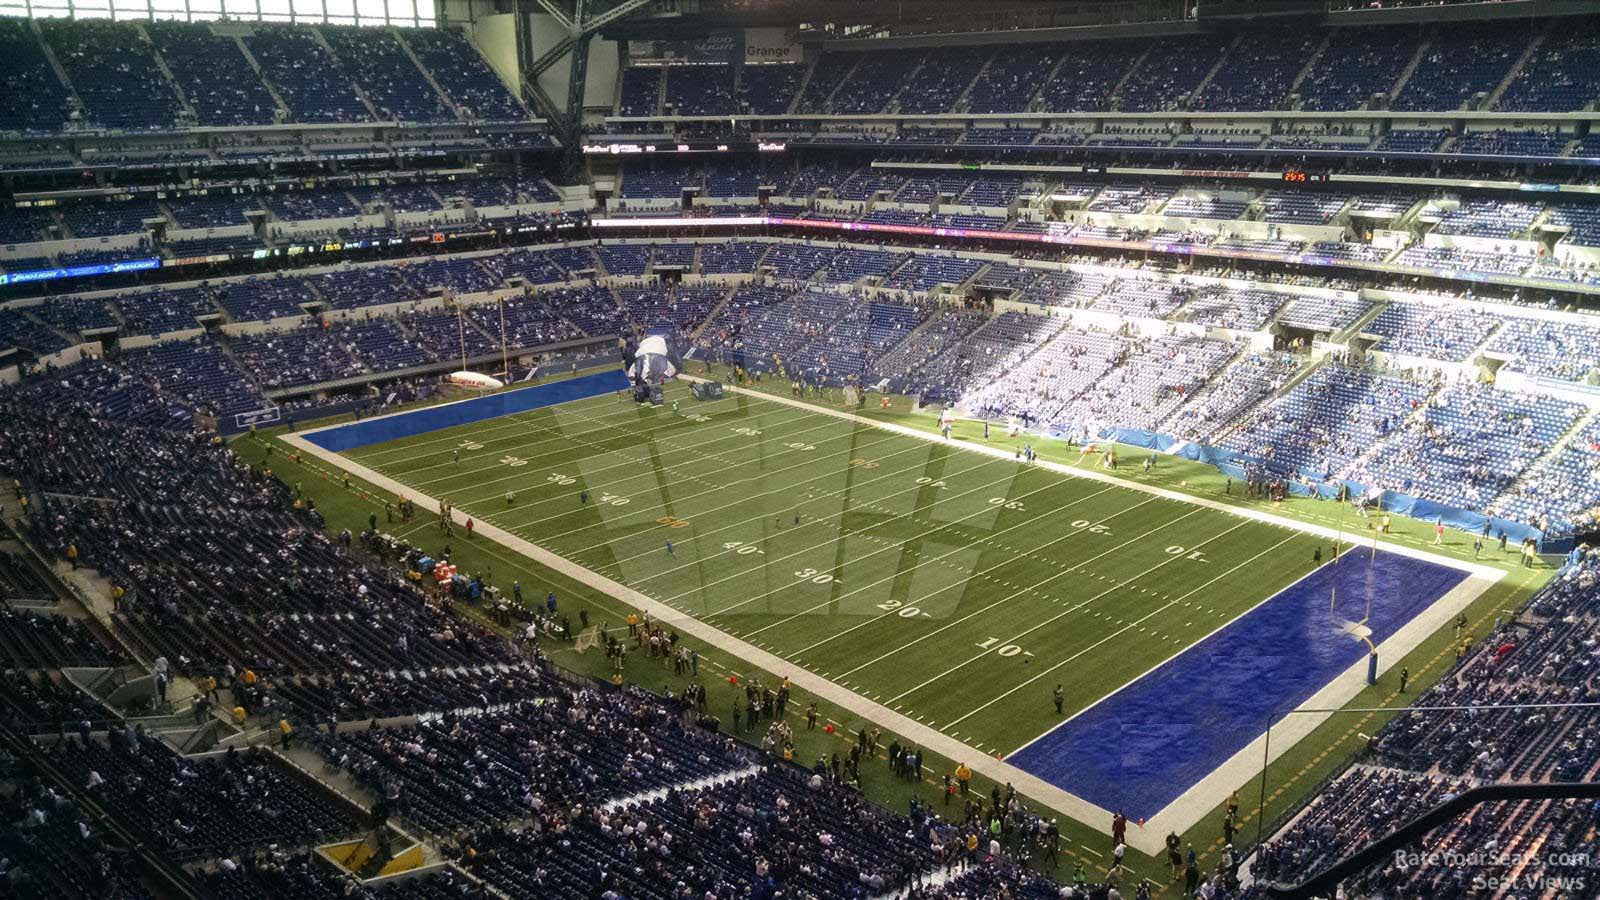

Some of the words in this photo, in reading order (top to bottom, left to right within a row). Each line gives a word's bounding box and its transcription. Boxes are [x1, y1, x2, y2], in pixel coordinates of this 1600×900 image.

[746, 47, 791, 57] Grange
[758, 143, 785, 151] FanDuel
[915, 476, 946, 489] 40
[988, 497, 1023, 510] 30
[1071, 519, 1105, 534] 20
[722, 542, 758, 555] 40
[1165, 545, 1206, 562] 10
[794, 568, 834, 584] 30
[876, 600, 921, 618] 20
[975, 636, 1022, 657] 10
